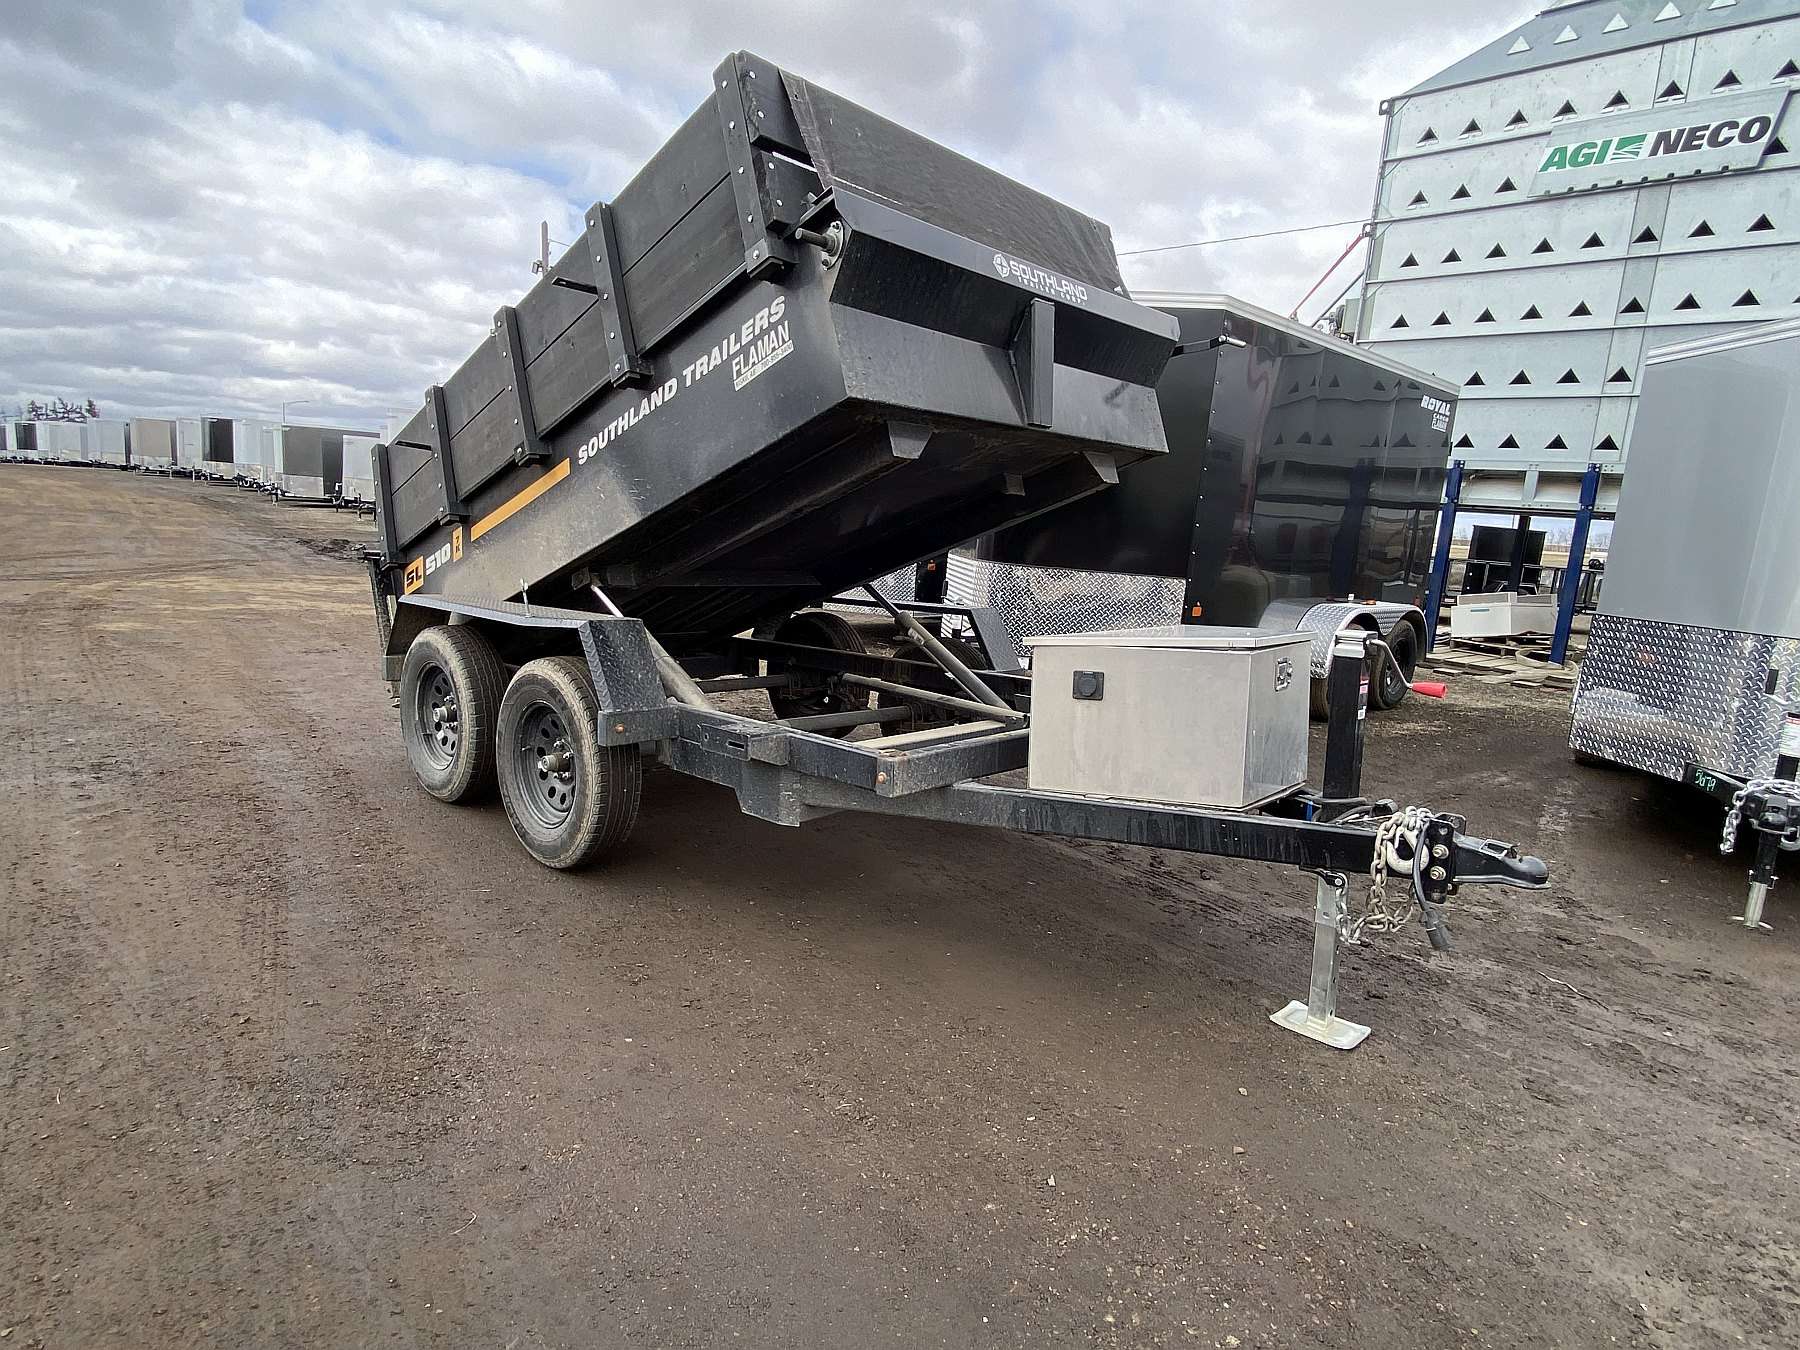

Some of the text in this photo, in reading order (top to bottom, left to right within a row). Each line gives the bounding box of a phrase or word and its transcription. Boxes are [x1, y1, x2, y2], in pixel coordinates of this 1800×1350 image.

[1538, 115, 1772, 172] AGI NECO
[1009, 260, 1088, 301] SOUTHLAND
[732, 320, 790, 380] FLAMAN
[578, 377, 678, 465] SOUTHLAND
[683, 295, 785, 387] TRAILERS
[1420, 394, 1451, 416] ROYAL
[425, 542, 451, 576] 510
